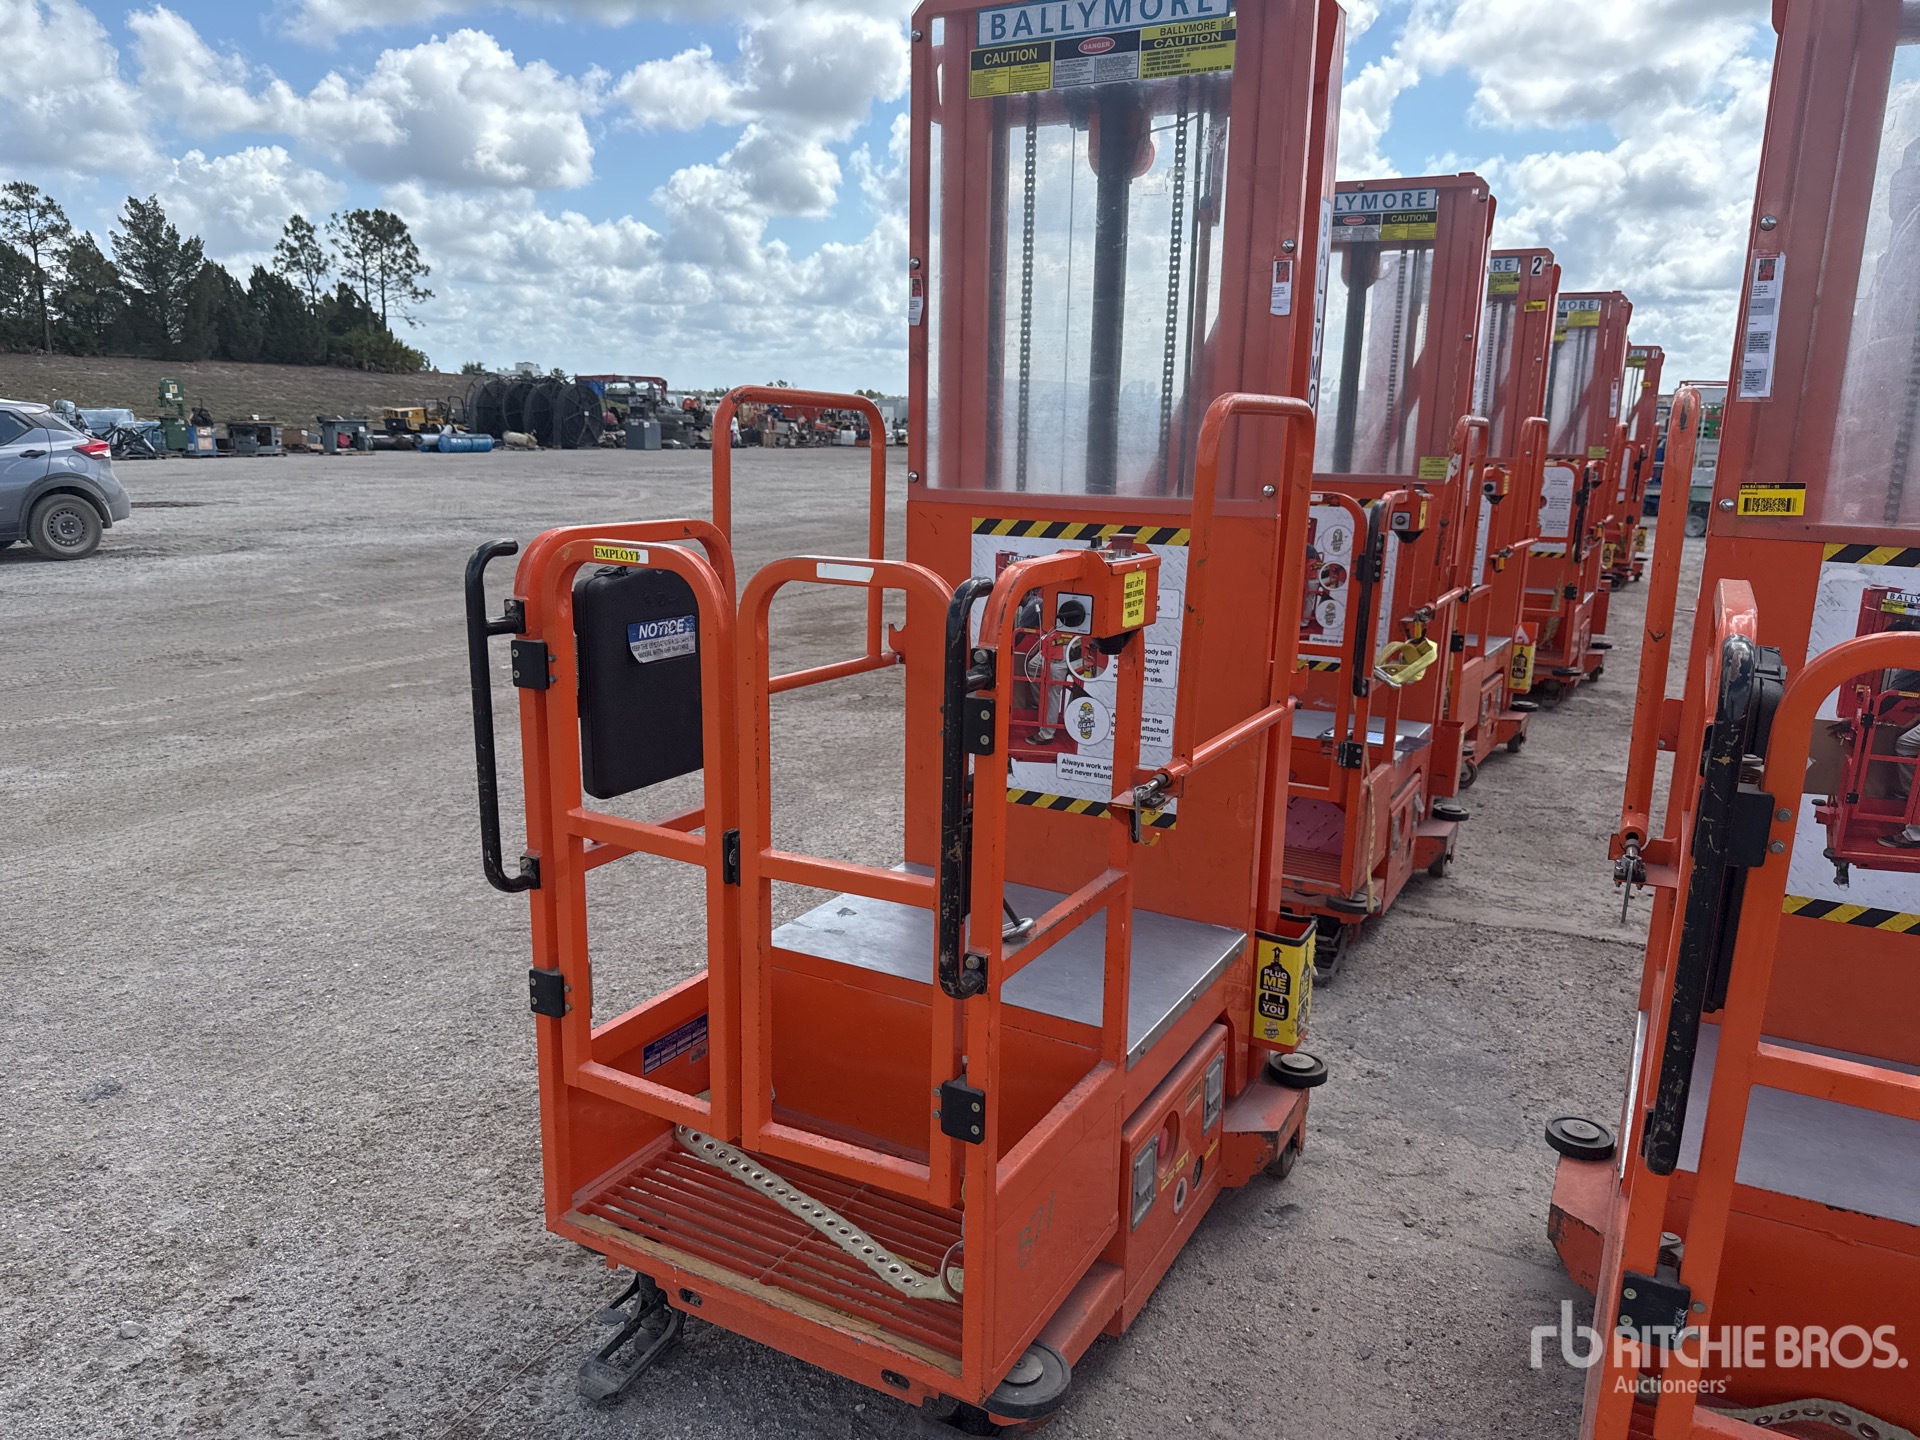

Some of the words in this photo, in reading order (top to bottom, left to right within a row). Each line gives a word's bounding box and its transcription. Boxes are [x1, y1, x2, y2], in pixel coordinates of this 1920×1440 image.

[1160, 21, 1216, 36] BALLYMORE
[1153, 31, 1222, 49] CAUTION
[1083, 41, 1110, 51] DANGER
[983, 47, 1037, 65] CAUTION
[1391, 214, 1428, 223] CAUTION
[1532, 257, 1542, 275] 2
[638, 618, 685, 639] NOTICE
[1145, 657, 1169, 665] lanyard
[1141, 726, 1169, 734] attached
[1061, 758, 1085, 768] Always
[1093, 772, 1112, 780] stand
[1264, 968, 1288, 979] PLUG
[1264, 975, 1287, 990] ME
[1262, 1004, 1285, 1015] YOU
